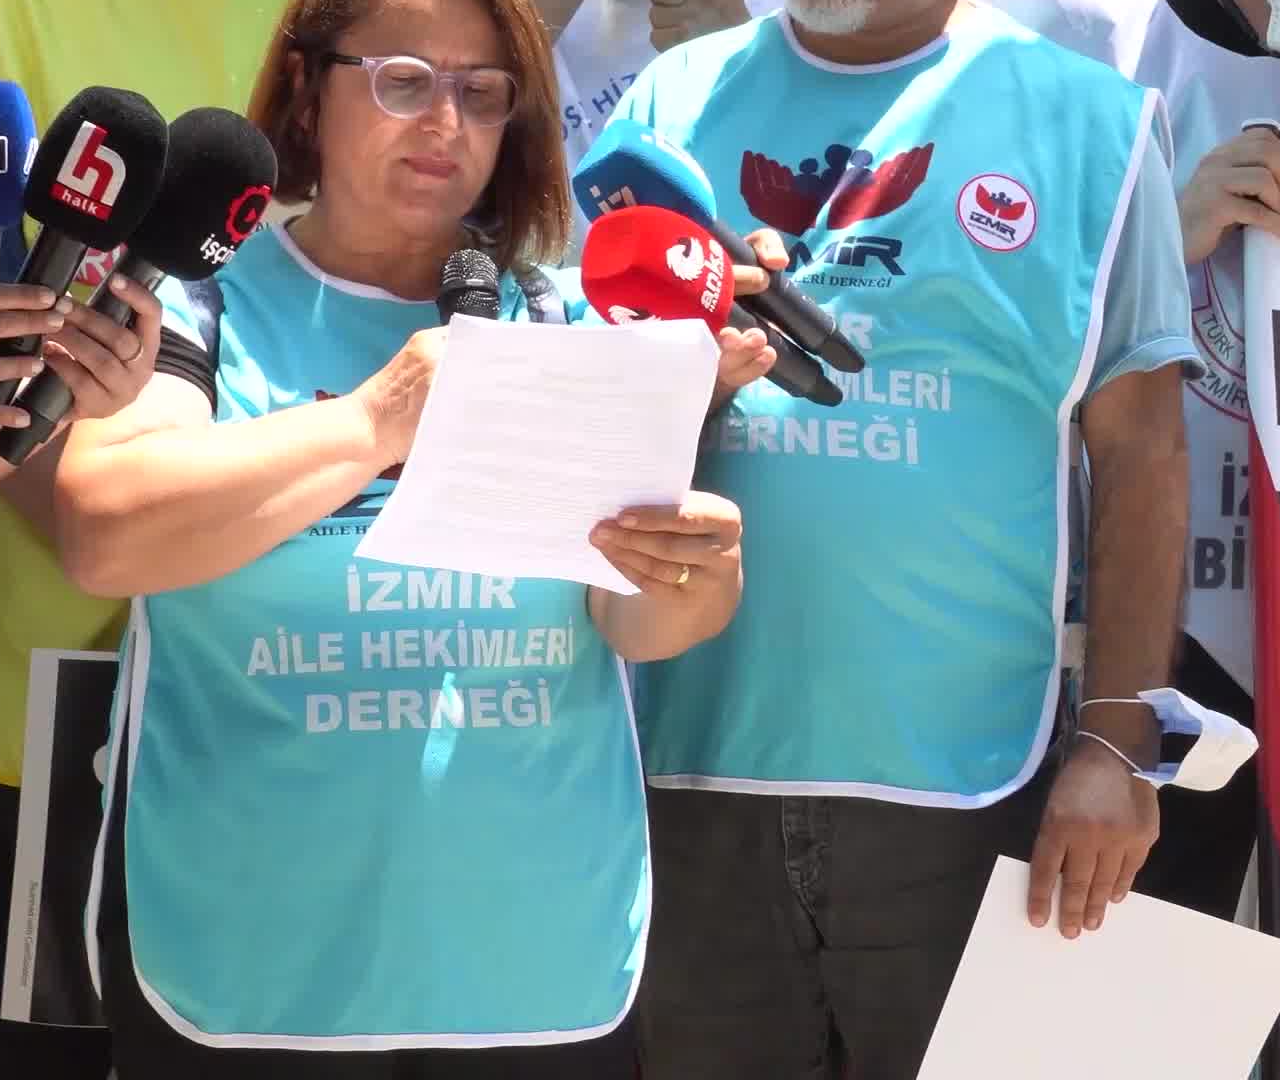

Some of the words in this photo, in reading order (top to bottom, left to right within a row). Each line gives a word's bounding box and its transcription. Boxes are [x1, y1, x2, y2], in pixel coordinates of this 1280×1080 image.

[61, 187, 99, 217] halk
[247, 625, 345, 677] AİLE
[361, 615, 577, 670] HEKİMLERİ
[305, 677, 552, 735] DERNEĞİ
